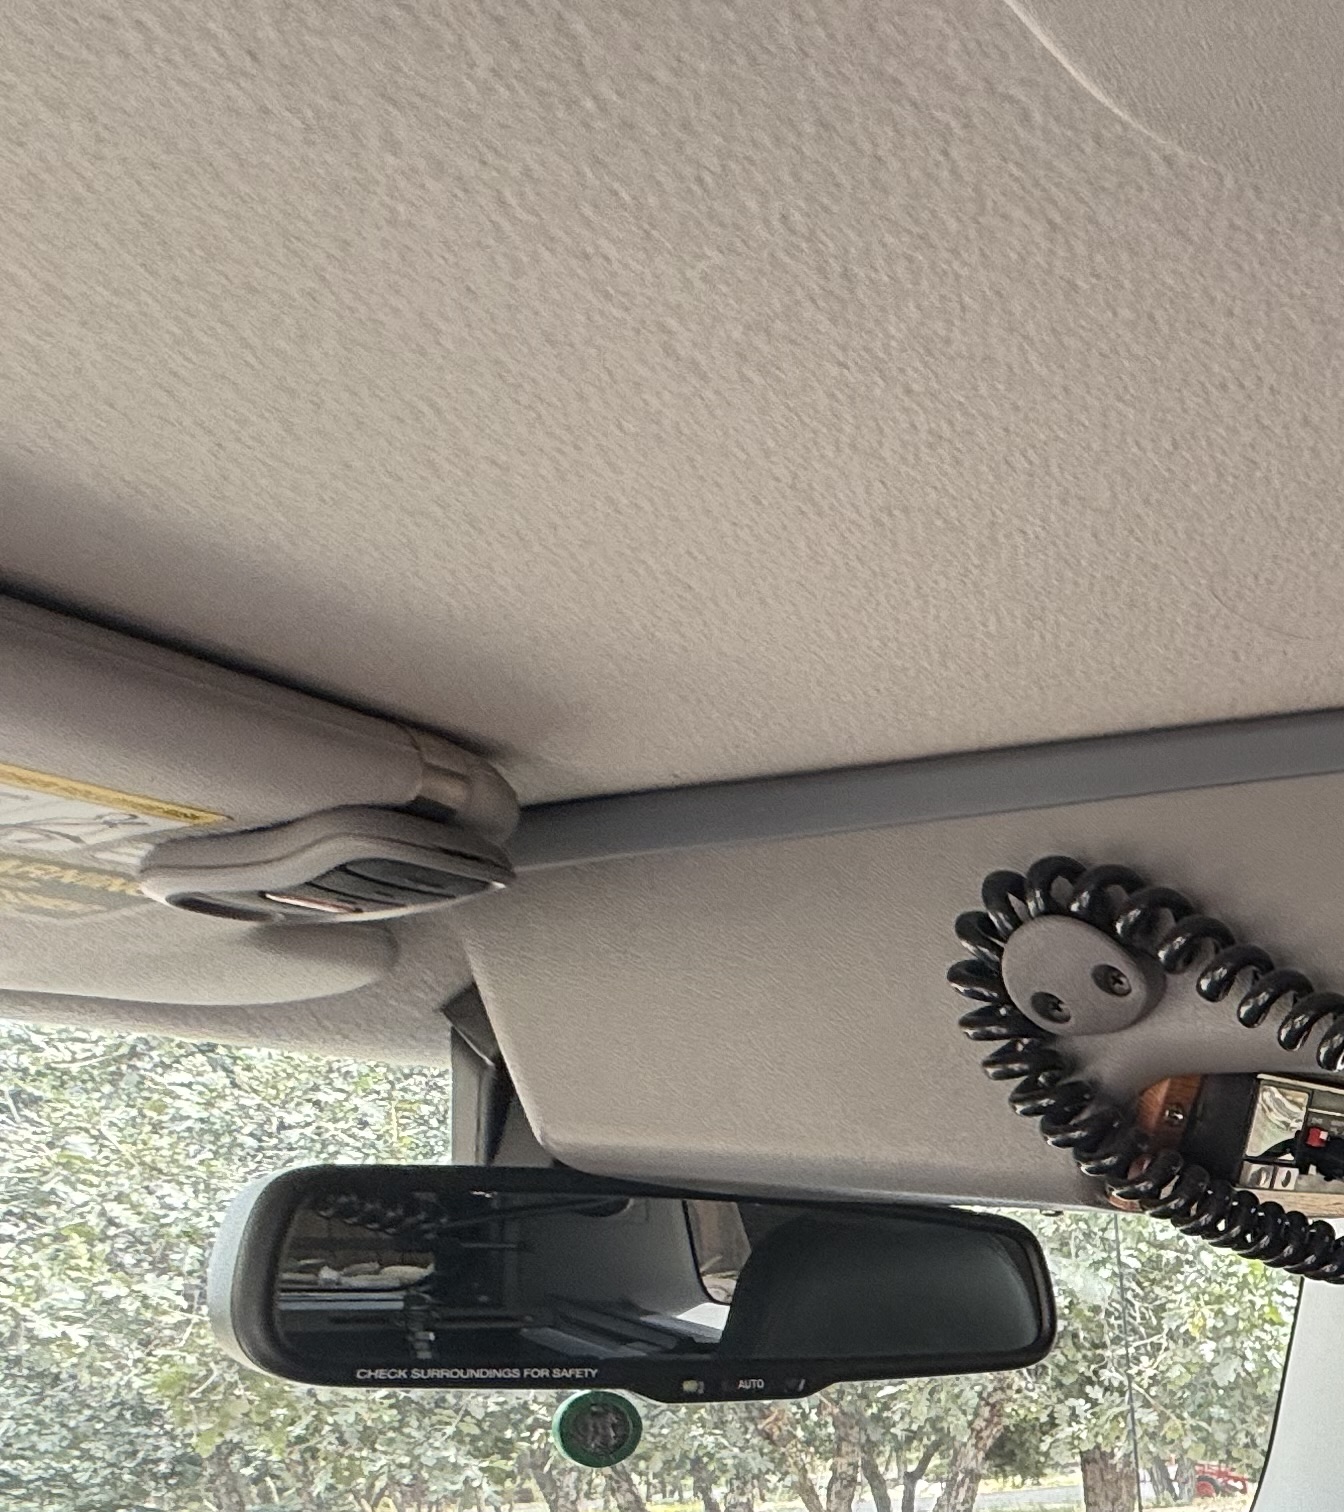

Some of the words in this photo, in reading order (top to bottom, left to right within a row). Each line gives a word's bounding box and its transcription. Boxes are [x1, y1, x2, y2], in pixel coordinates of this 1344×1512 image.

[356, 1368, 408, 1380] CHECK
[410, 1368, 521, 1379] SURROUNDINGS
[523, 1368, 550, 1379] FOR
[551, 1368, 599, 1379] SAFETY
[738, 1379, 765, 1390] AUTO
